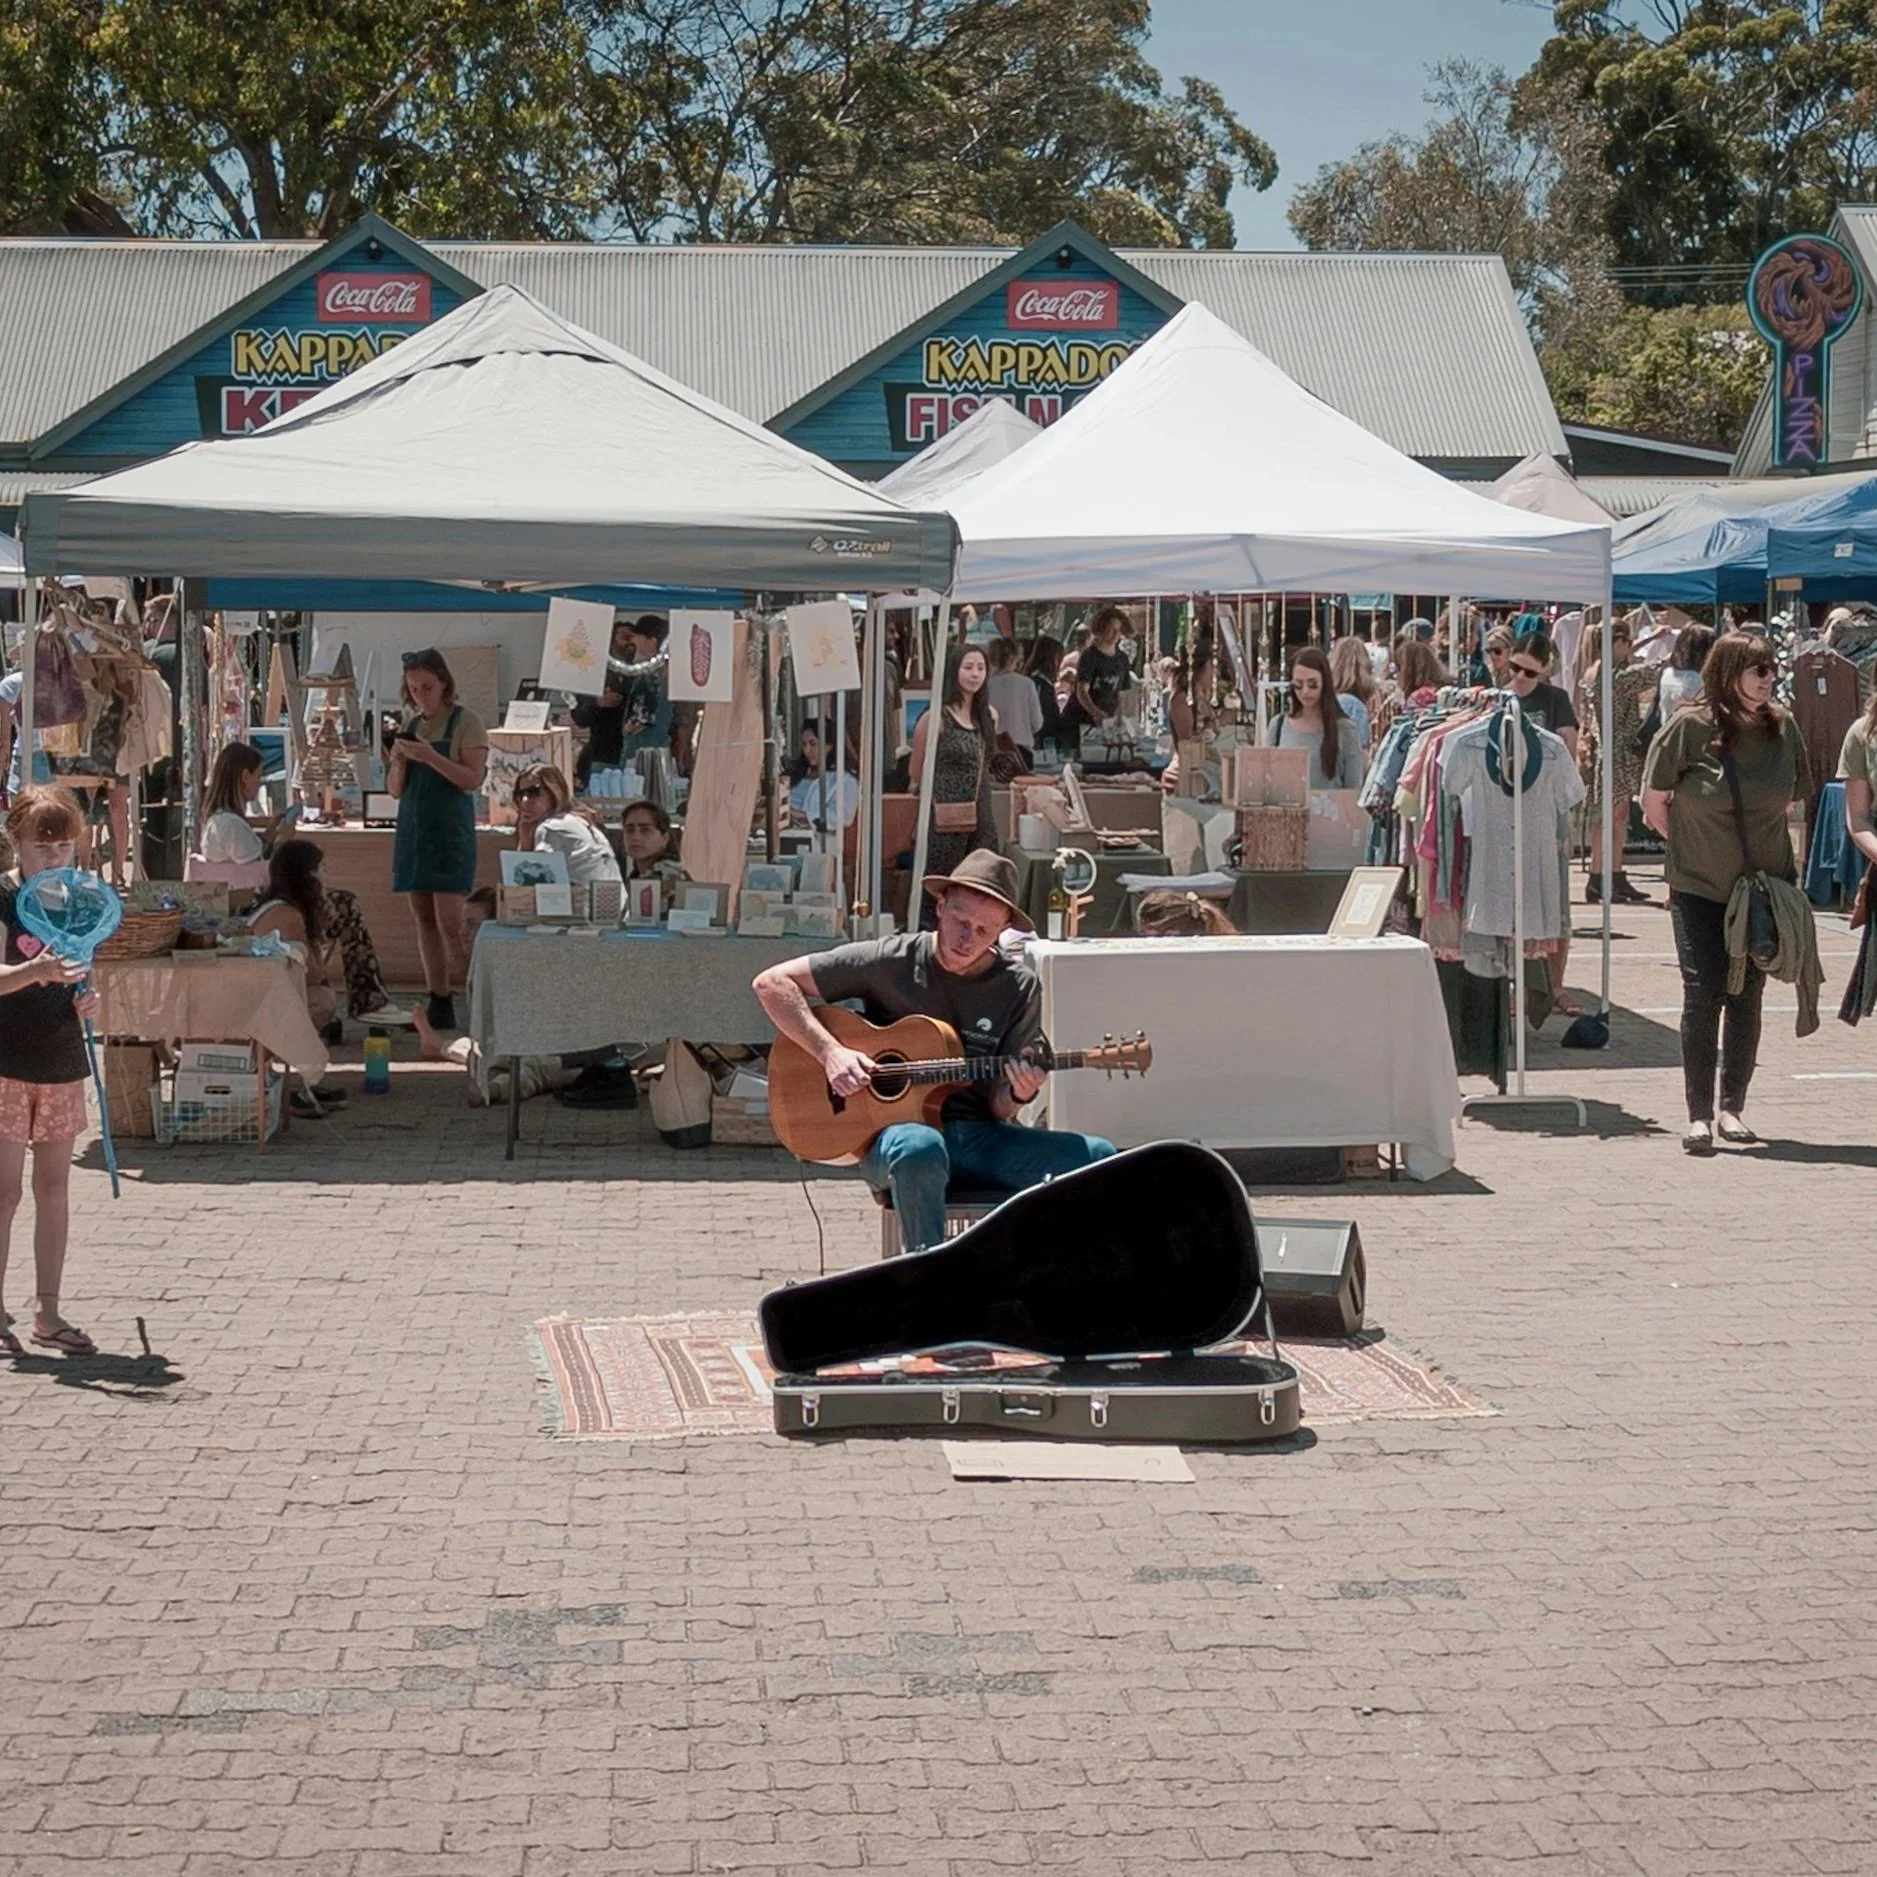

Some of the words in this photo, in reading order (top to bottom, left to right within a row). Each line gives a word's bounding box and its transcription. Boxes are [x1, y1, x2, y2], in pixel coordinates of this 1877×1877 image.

[325, 280, 420, 314] Coca-Cola
[1015, 288, 1110, 321] Coca-Cola
[924, 337, 1140, 390] KAPPADO
[906, 393, 1015, 441] FIS
[1785, 353, 1816, 461] PIZZA
